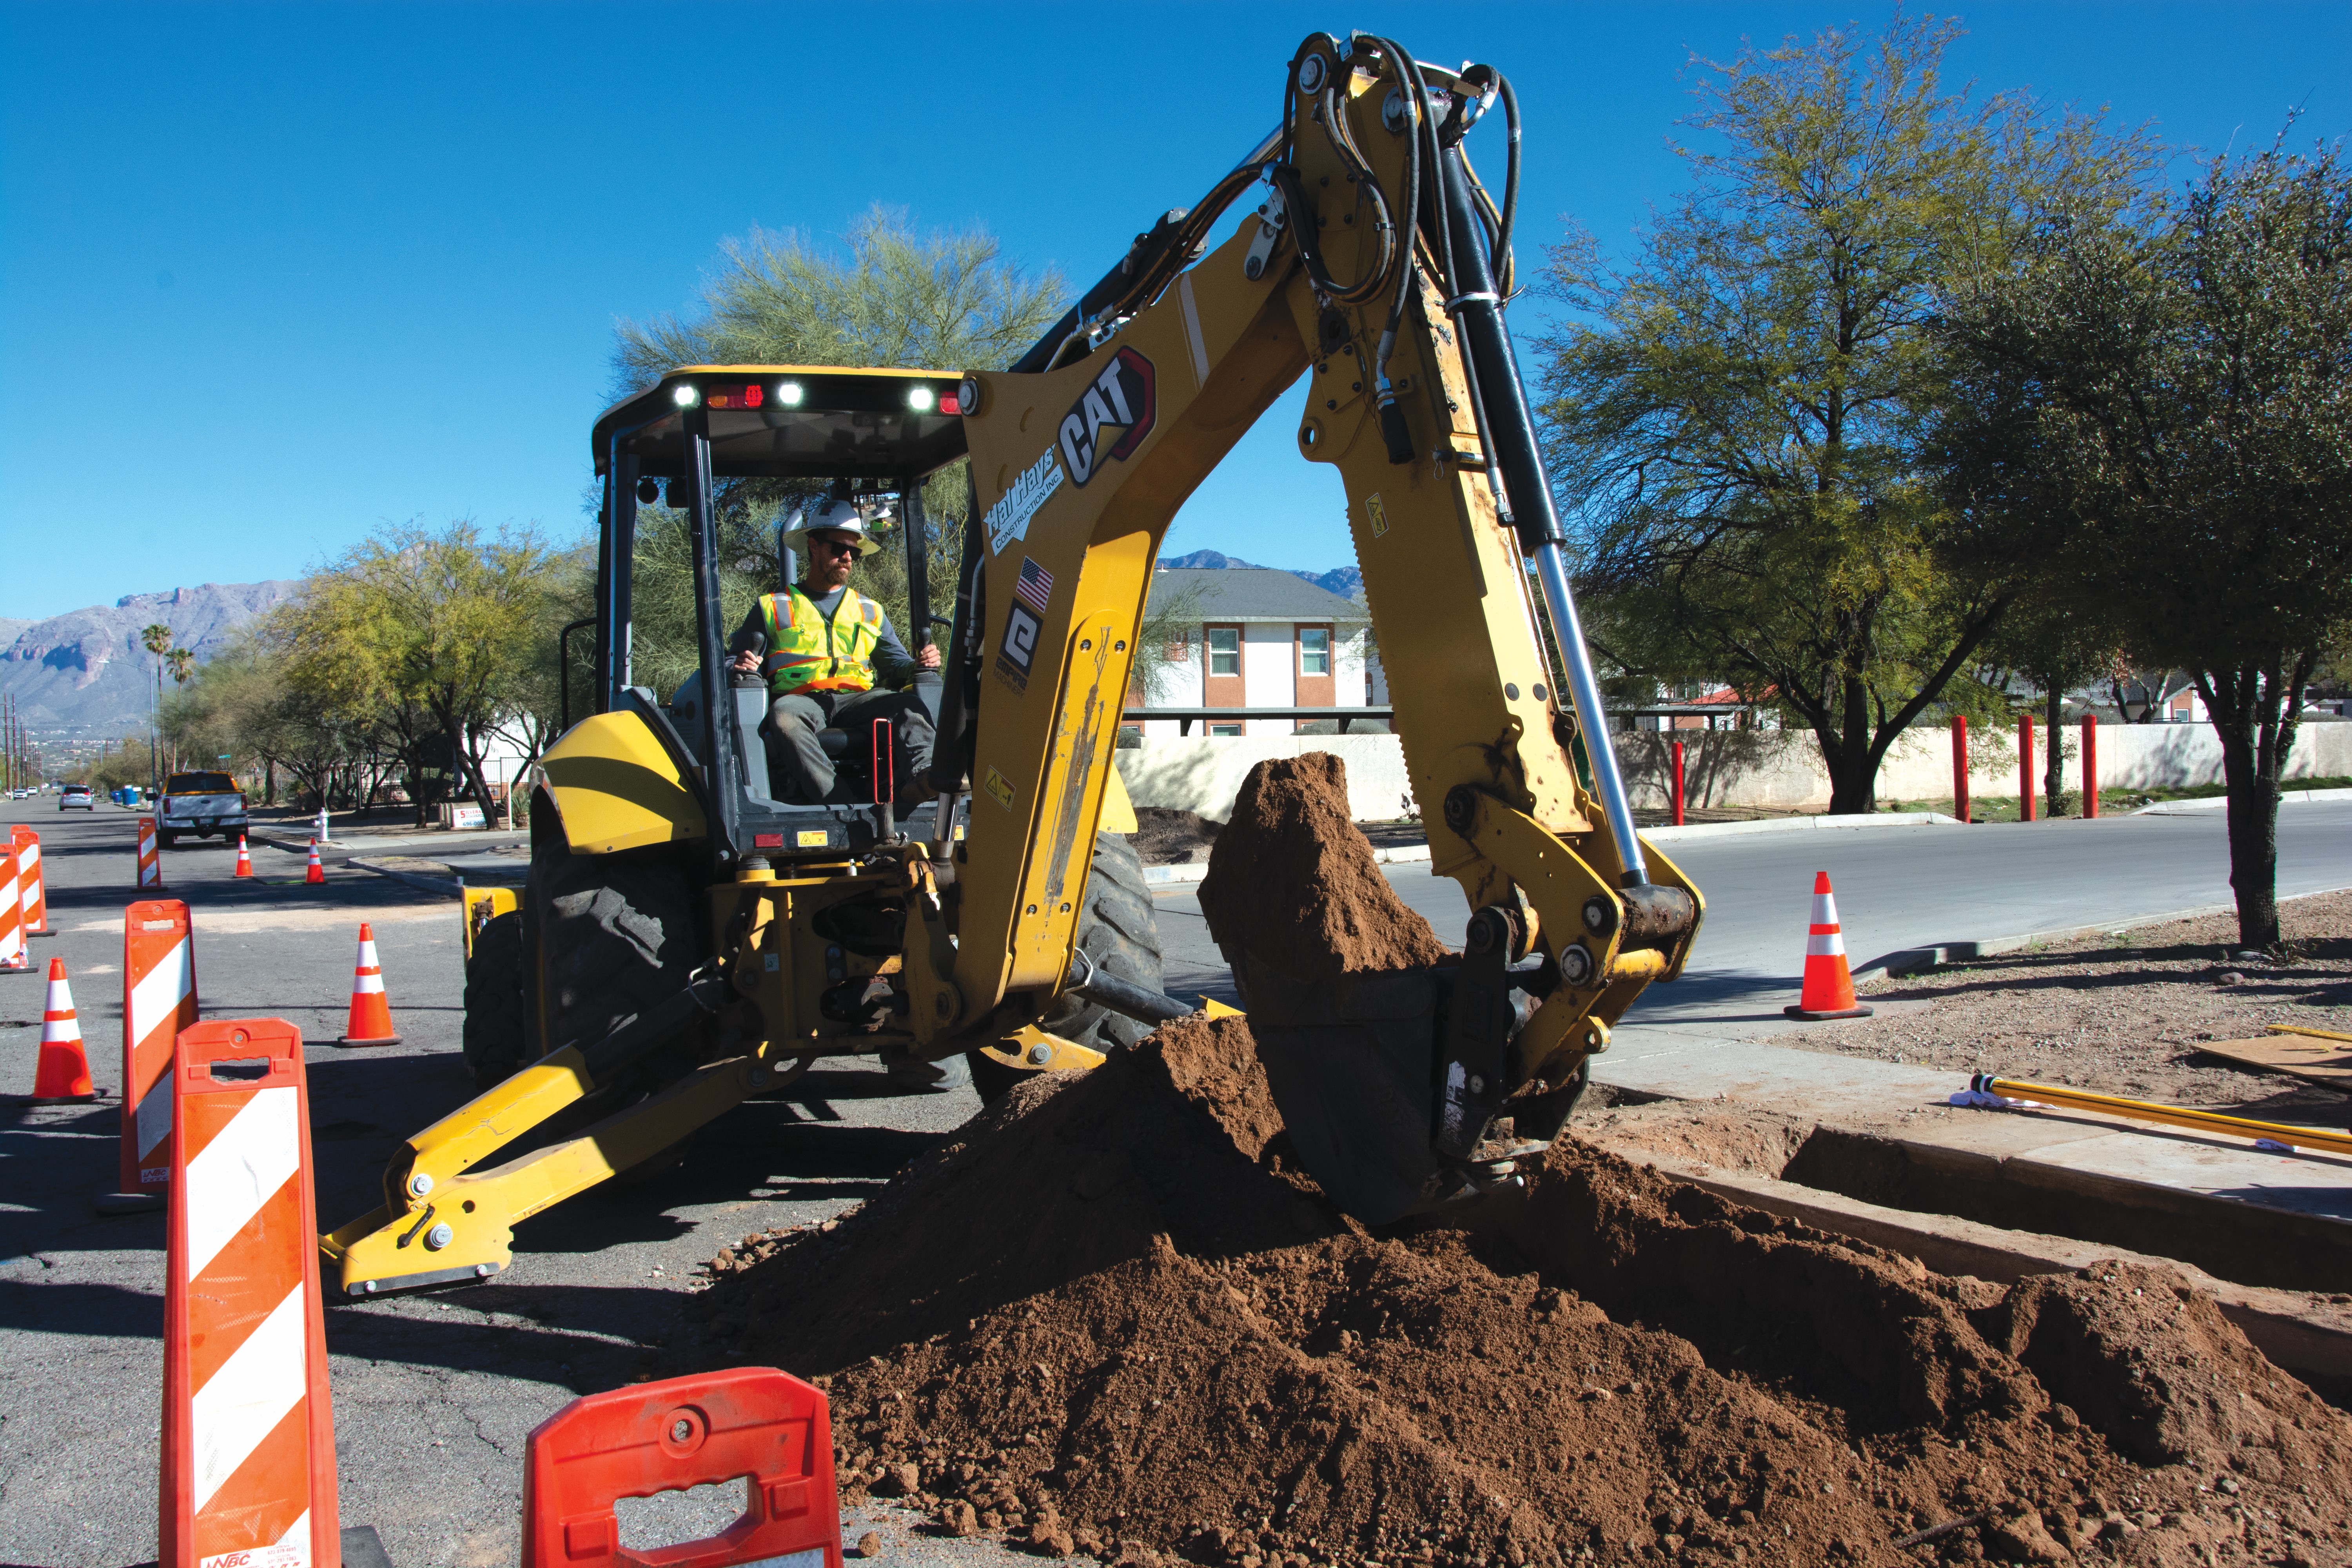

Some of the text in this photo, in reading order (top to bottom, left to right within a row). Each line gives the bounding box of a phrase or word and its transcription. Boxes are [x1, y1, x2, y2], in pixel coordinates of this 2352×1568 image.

[1059, 357, 1133, 483] CAT
[987, 447, 1054, 538] Hal Hays
[995, 474, 1061, 549] CONSTRUCTION INC.
[460, 810, 482, 818] SILVERA
[207, 1553, 251, 1568] NBC
